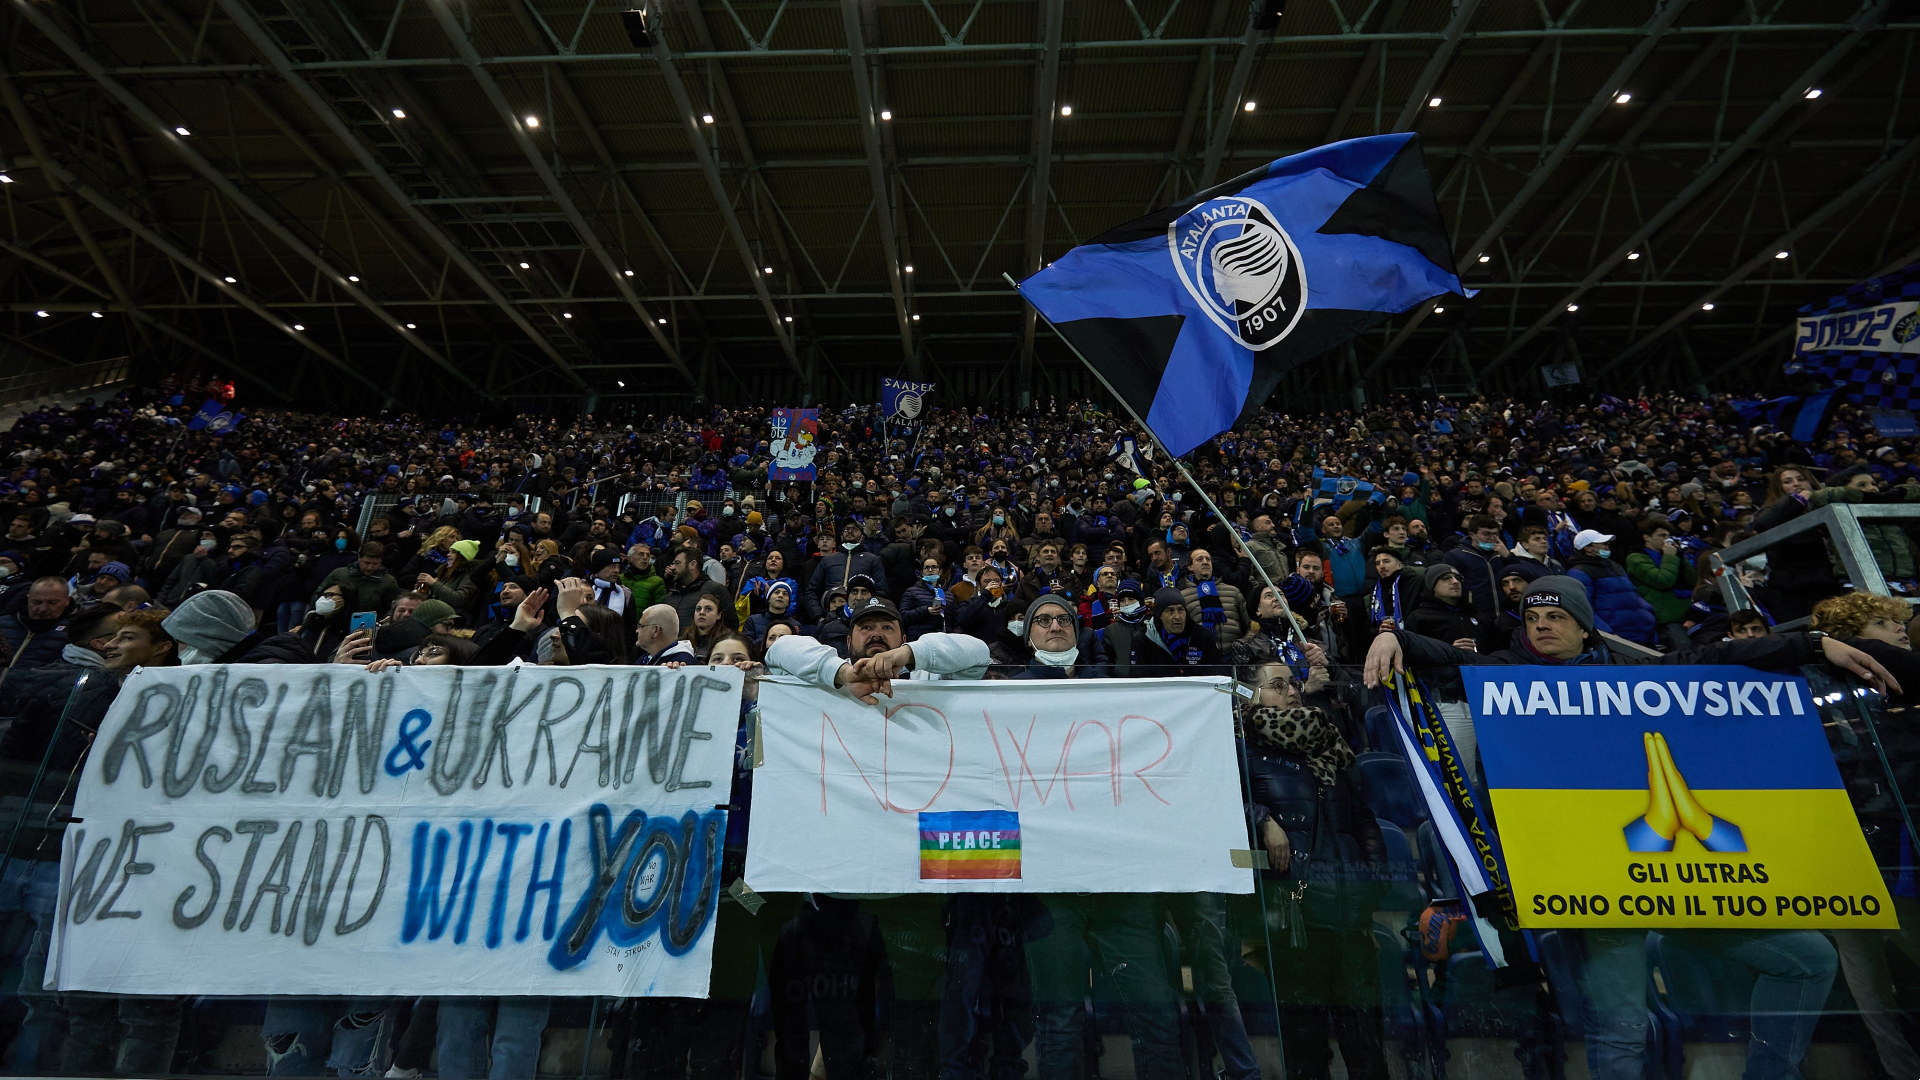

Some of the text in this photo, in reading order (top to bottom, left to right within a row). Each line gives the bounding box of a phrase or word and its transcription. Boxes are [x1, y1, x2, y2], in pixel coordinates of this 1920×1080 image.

[1180, 203, 1246, 260] ATALANTA
[1245, 295, 1287, 335] 1907
[1482, 680, 1804, 717] MALINOVSKYI
[102, 666, 732, 799] RUSLAN & UKRAINE
[821, 703, 1172, 815] NO WAR
[938, 830, 1001, 849] PEACE
[647, 861, 657, 870] NO
[1627, 862, 1770, 884] GLI ULTRAS
[67, 804, 726, 972] WE STAND WITH YOU
[1533, 894, 1881, 917] SONO CON IL TUO POPOLO
[624, 940, 651, 958] STRONG
